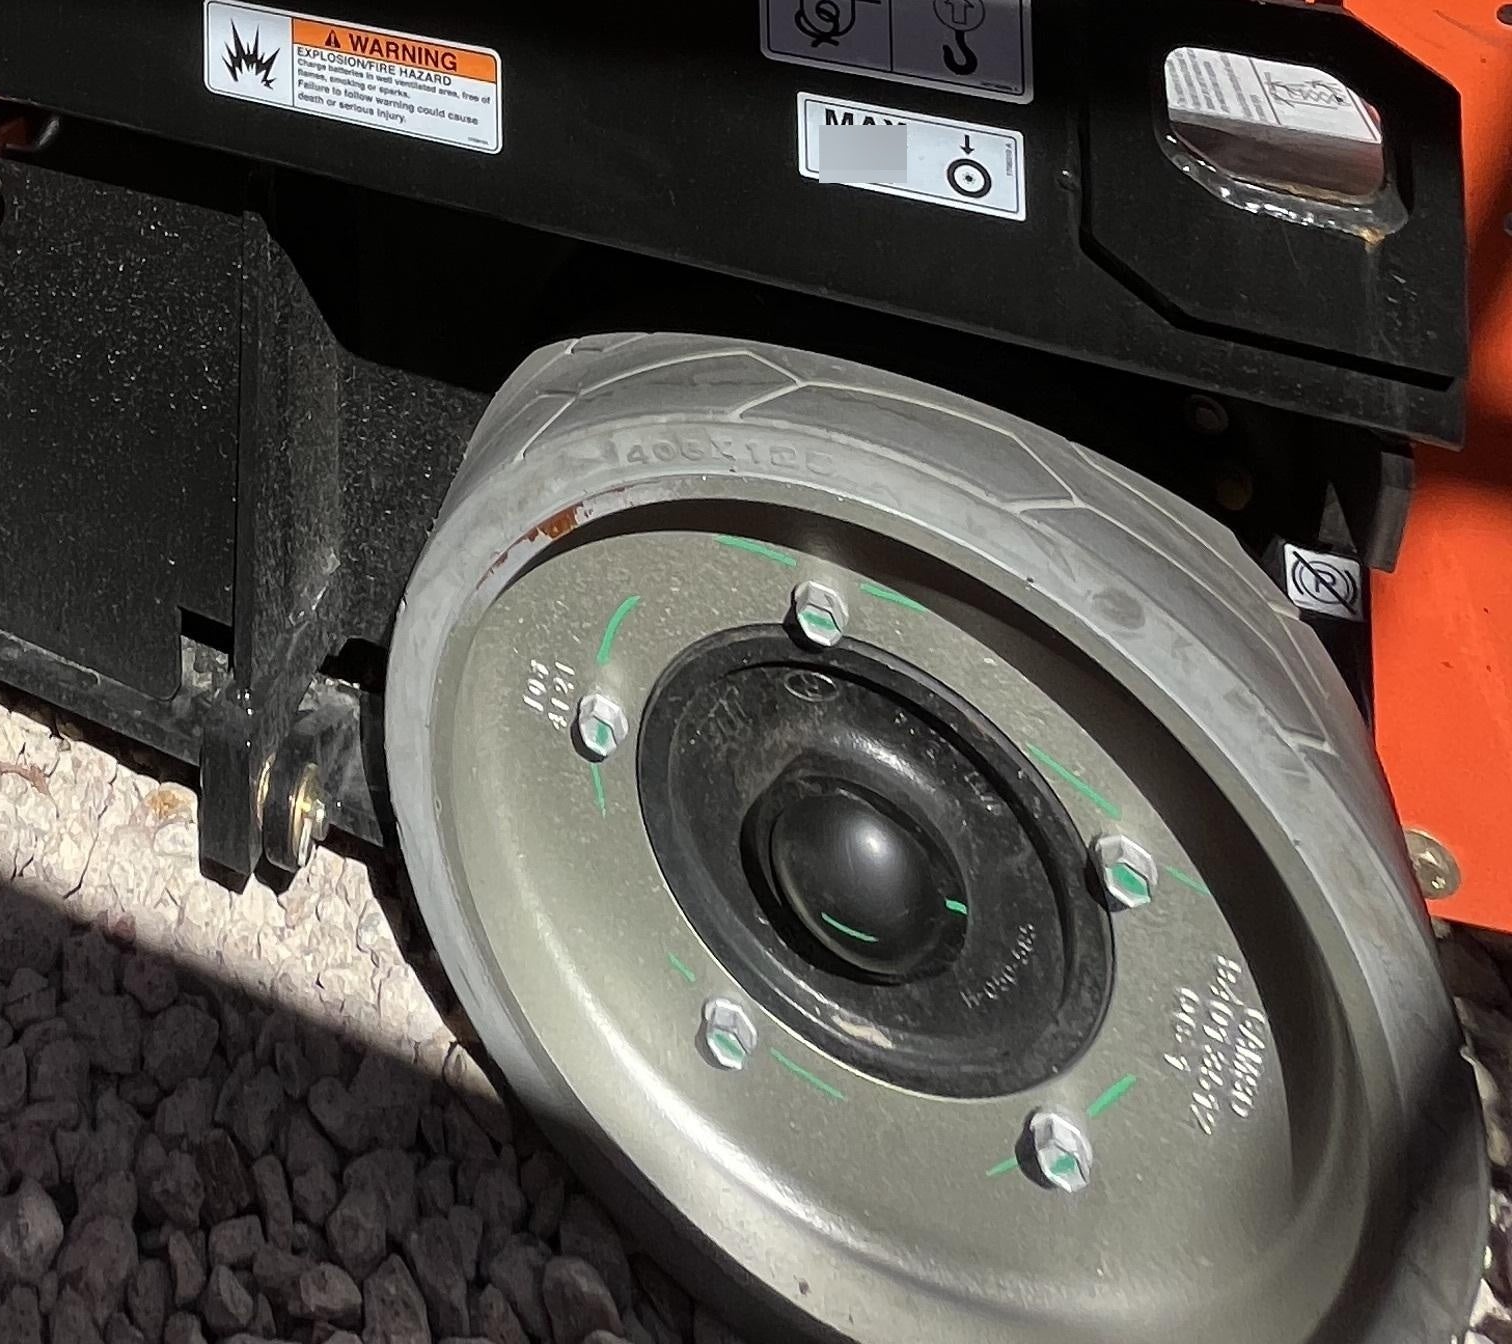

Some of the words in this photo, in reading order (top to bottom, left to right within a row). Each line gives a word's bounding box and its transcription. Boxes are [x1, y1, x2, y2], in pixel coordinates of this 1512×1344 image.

[297, 46, 396, 75] EXPLOSION/FIRE
[399, 68, 452, 87] HAZARD
[349, 33, 458, 72] WARNING
[297, 58, 327, 71] Charge
[328, 63, 364, 79] batteries
[366, 71, 374, 80] in
[376, 73, 393, 84] well
[394, 78, 436, 94] ventilated
[438, 87, 460, 99] area,
[461, 90, 480, 103] free
[481, 96, 491, 105] of
[297, 68, 328, 82] flames,
[329, 76, 366, 91] smoking
[367, 83, 377, 91] or
[378, 85, 410, 99] sparks.
[297, 79, 330, 94] Failure
[332, 86, 342, 96] to
[344, 88, 373, 103] follow
[375, 97, 415, 113] warning
[416, 105, 446, 119] could
[447, 113, 478, 125] cause
[297, 92, 324, 104] death
[326, 98, 337, 107] or
[339, 100, 374, 115] serious
[376, 107, 407, 124] injury.
